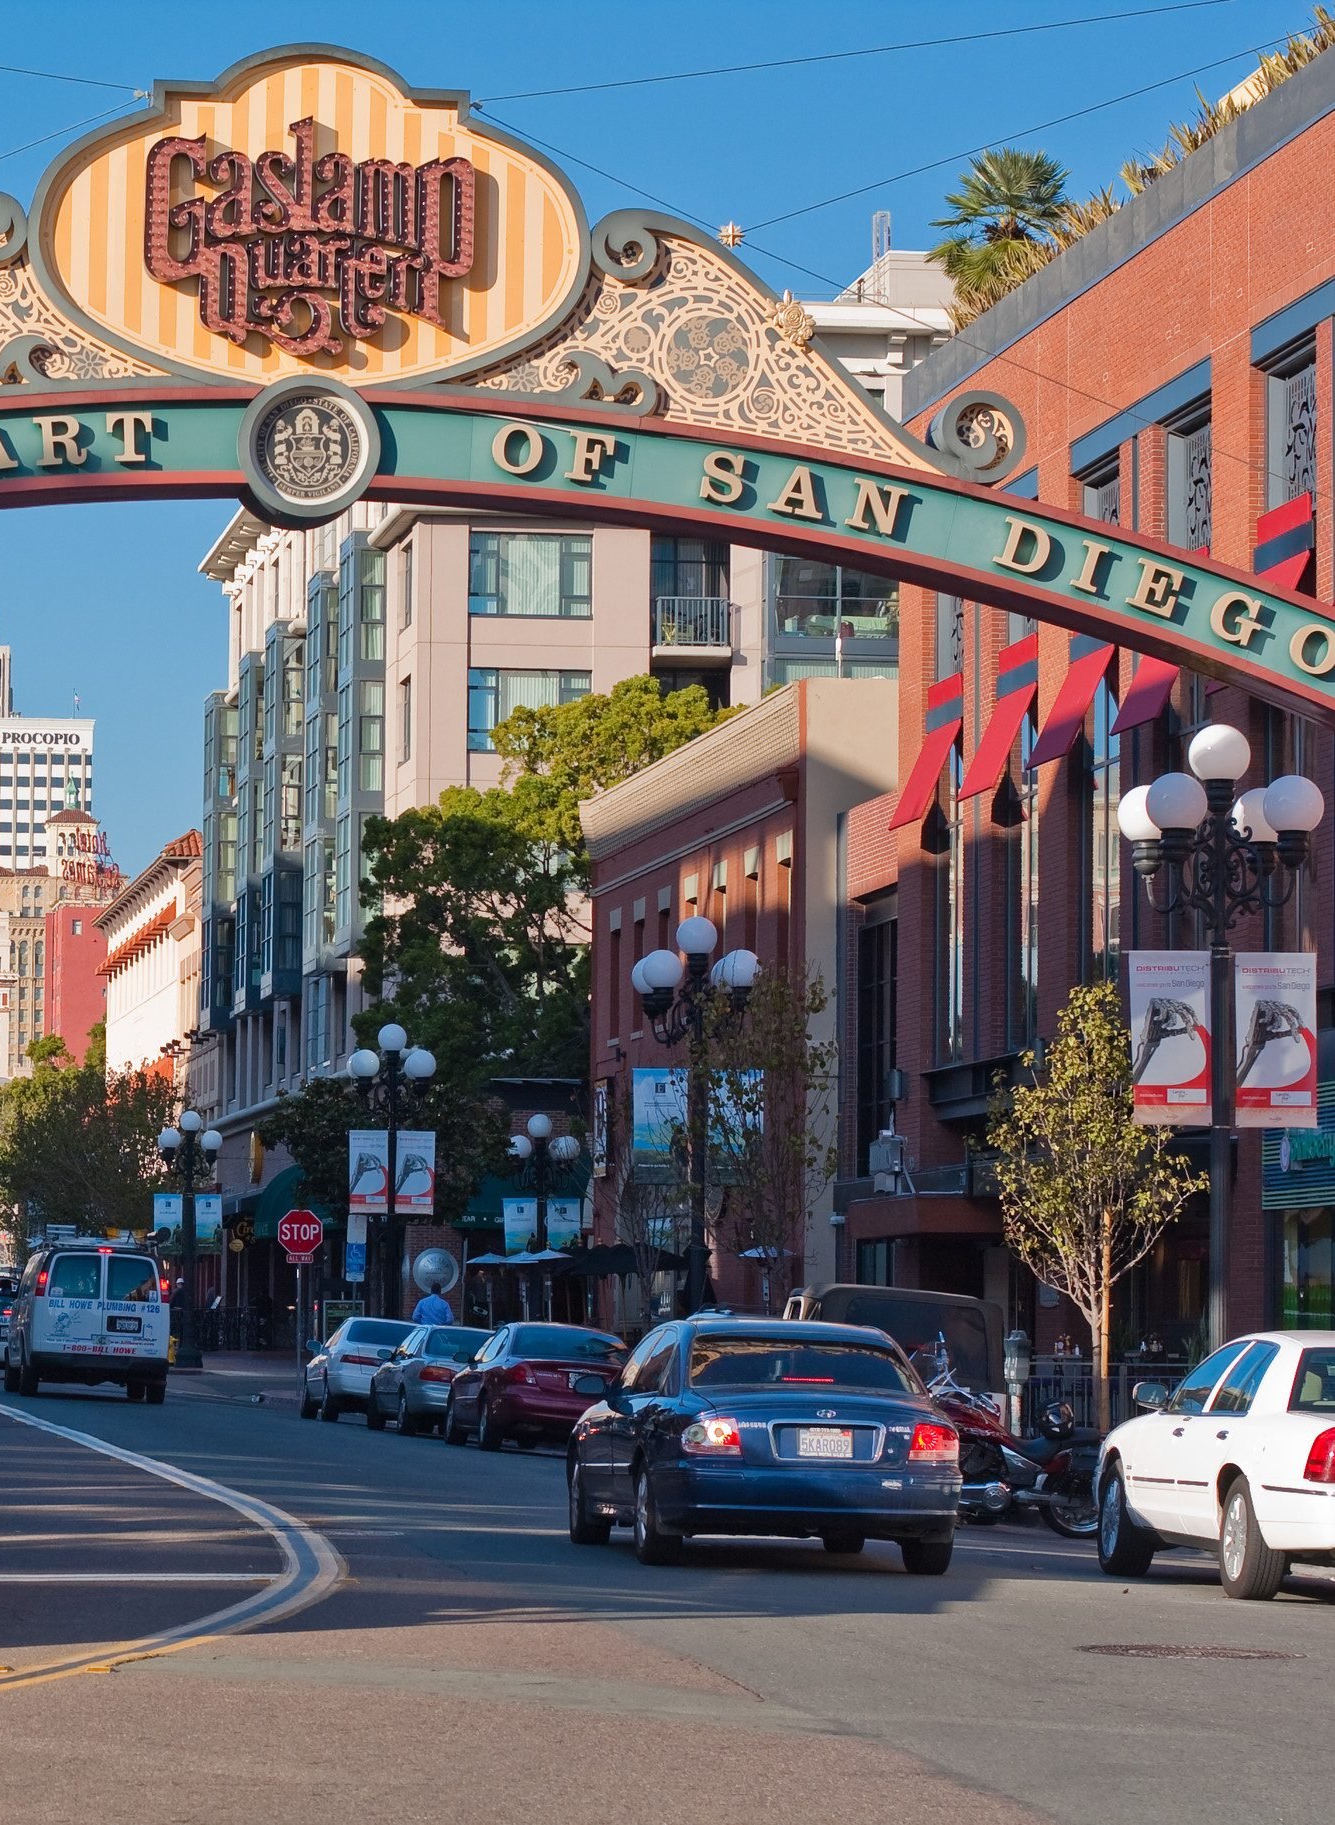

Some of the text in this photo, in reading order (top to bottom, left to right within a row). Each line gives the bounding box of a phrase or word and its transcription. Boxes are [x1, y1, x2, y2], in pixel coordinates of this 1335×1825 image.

[143, 116, 475, 330] Gaslamp
[198, 230, 428, 356] Quarter
[312, 398, 343, 414] STATE
[343, 425, 361, 479] CALIFORNIA
[278, 482, 340, 498] SEMPER VIGILANS
[491, 422, 616, 483] OF
[699, 450, 910, 536] SAN
[992, 515, 1335, 676] DIEGO
[2, 731, 80, 745] PROCOPIO
[1171, 979, 1185, 988] San
[1185, 979, 1205, 990] Diego
[1277, 981, 1291, 990] San
[1291, 981, 1311, 992] Diego
[281, 1223, 320, 1241] STOP
[288, 1254, 312, 1262] ALL WAY
[48, 1299, 160, 1314] BILL HOWE PLUMBING #126
[62, 1345, 110, 1355] 1-800-BILL
[113, 1346, 137, 1355] HOWE
[801, 1437, 850, 1452] 5KAR089
